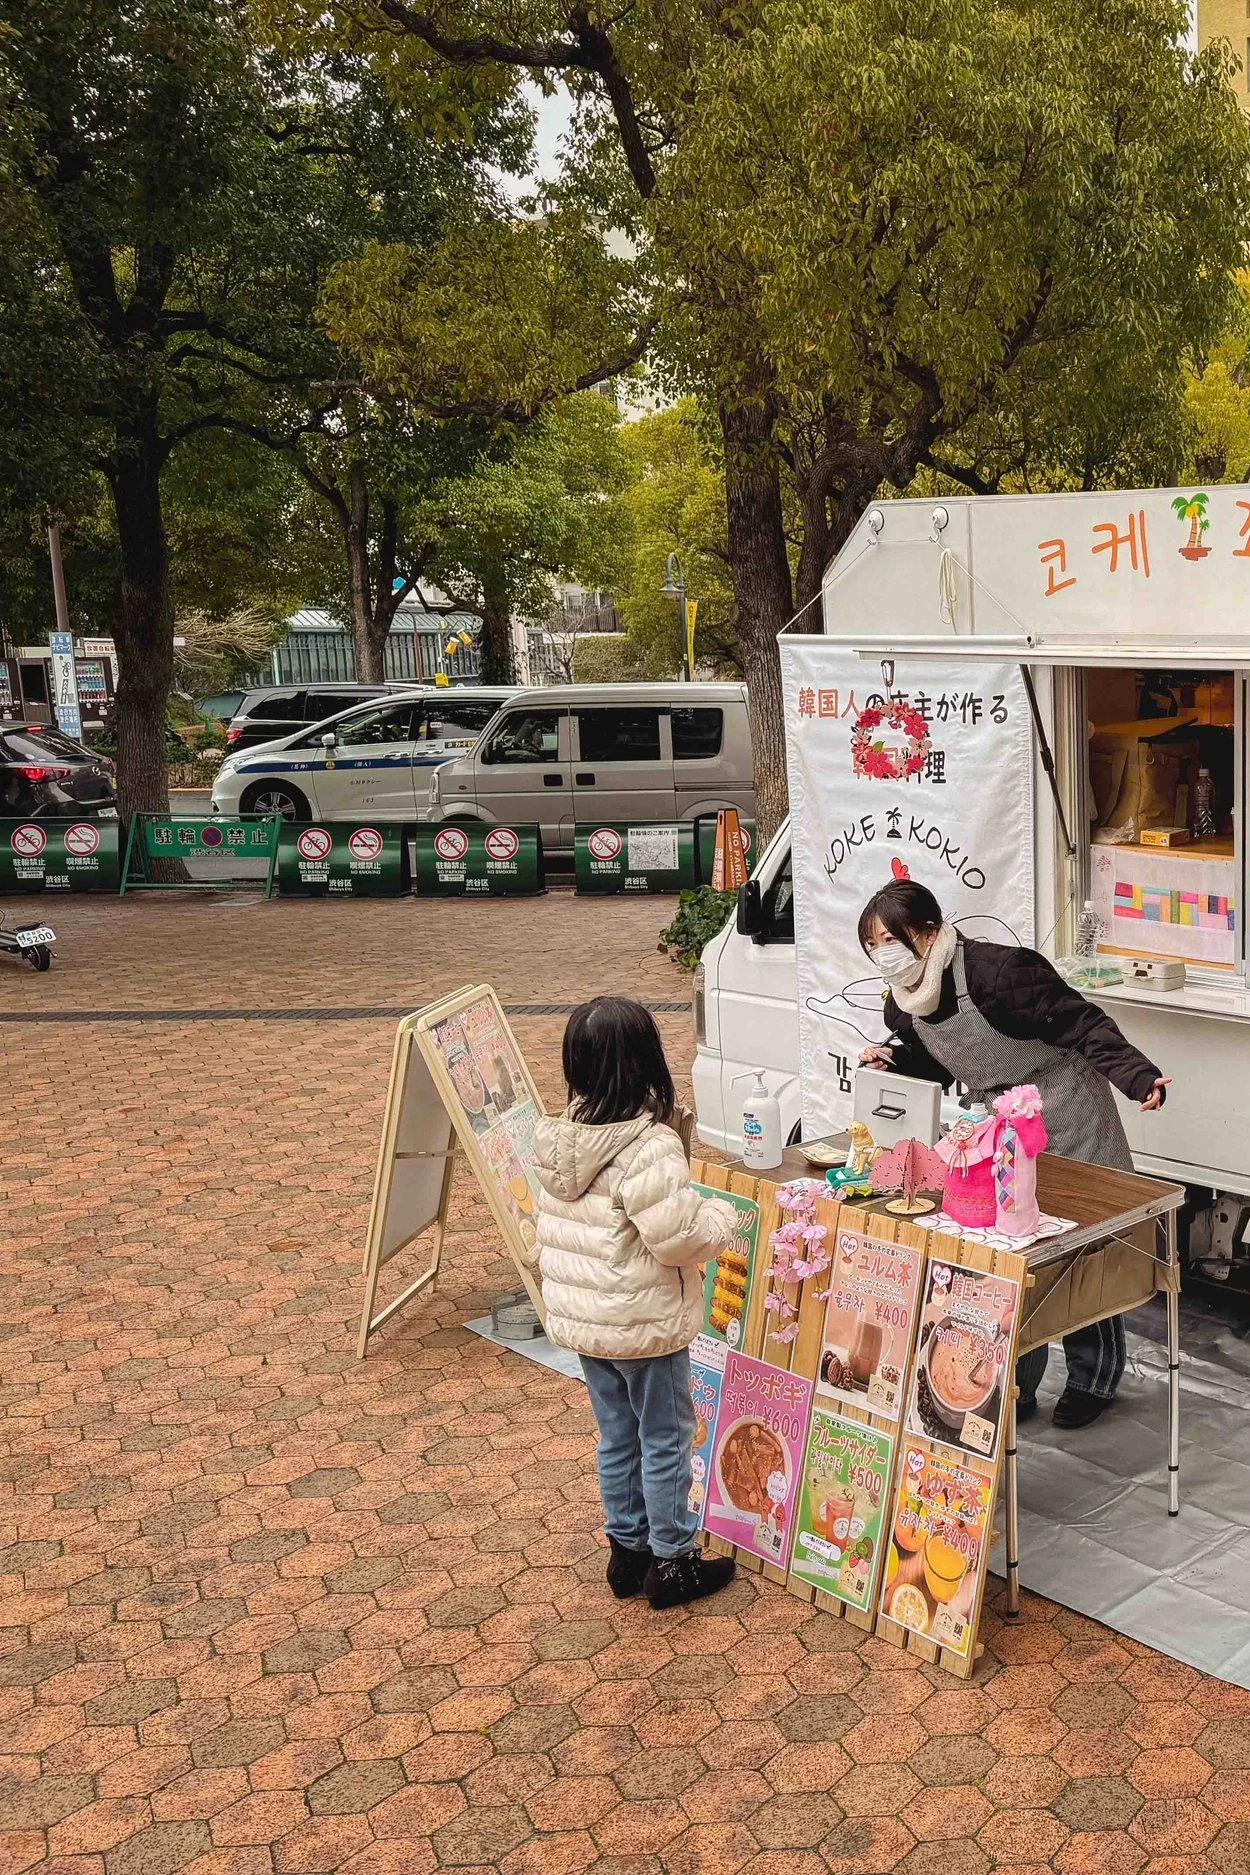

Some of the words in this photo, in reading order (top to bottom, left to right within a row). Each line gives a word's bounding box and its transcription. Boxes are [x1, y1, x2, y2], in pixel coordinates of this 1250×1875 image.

[1037, 508, 1151, 597] 코케
[154, 828, 196, 846] 駐輪
[227, 828, 269, 846] 禁止
[732, 831, 740, 847] NO
[823, 814, 876, 884] KOKE
[908, 816, 985, 890] KOKIO
[733, 849, 743, 886] PARKI
[24, 931, 54, 945] 5200
[842, 1240, 857, 1251] Hot
[857, 1254, 913, 1287] ユルム茶
[934, 1270, 950, 1282] Hot
[951, 1272, 1013, 1310] 韓国コーヒー
[835, 1291, 866, 1313] 율무차
[874, 1301, 908, 1329] ¥400
[936, 1327, 962, 1350] 커피
[968, 1334, 1005, 1367] ¥350
[729, 1359, 808, 1411] トッポギ
[726, 1389, 759, 1418] 떡볶이
[762, 1405, 800, 1442] ¥600
[812, 1425, 887, 1466] フルーツサイダー
[909, 1454, 923, 1467] Hot
[848, 1463, 882, 1495] ¥500
[925, 1472, 984, 1517] ゆず茶
[941, 1523, 979, 1560] ¥400
